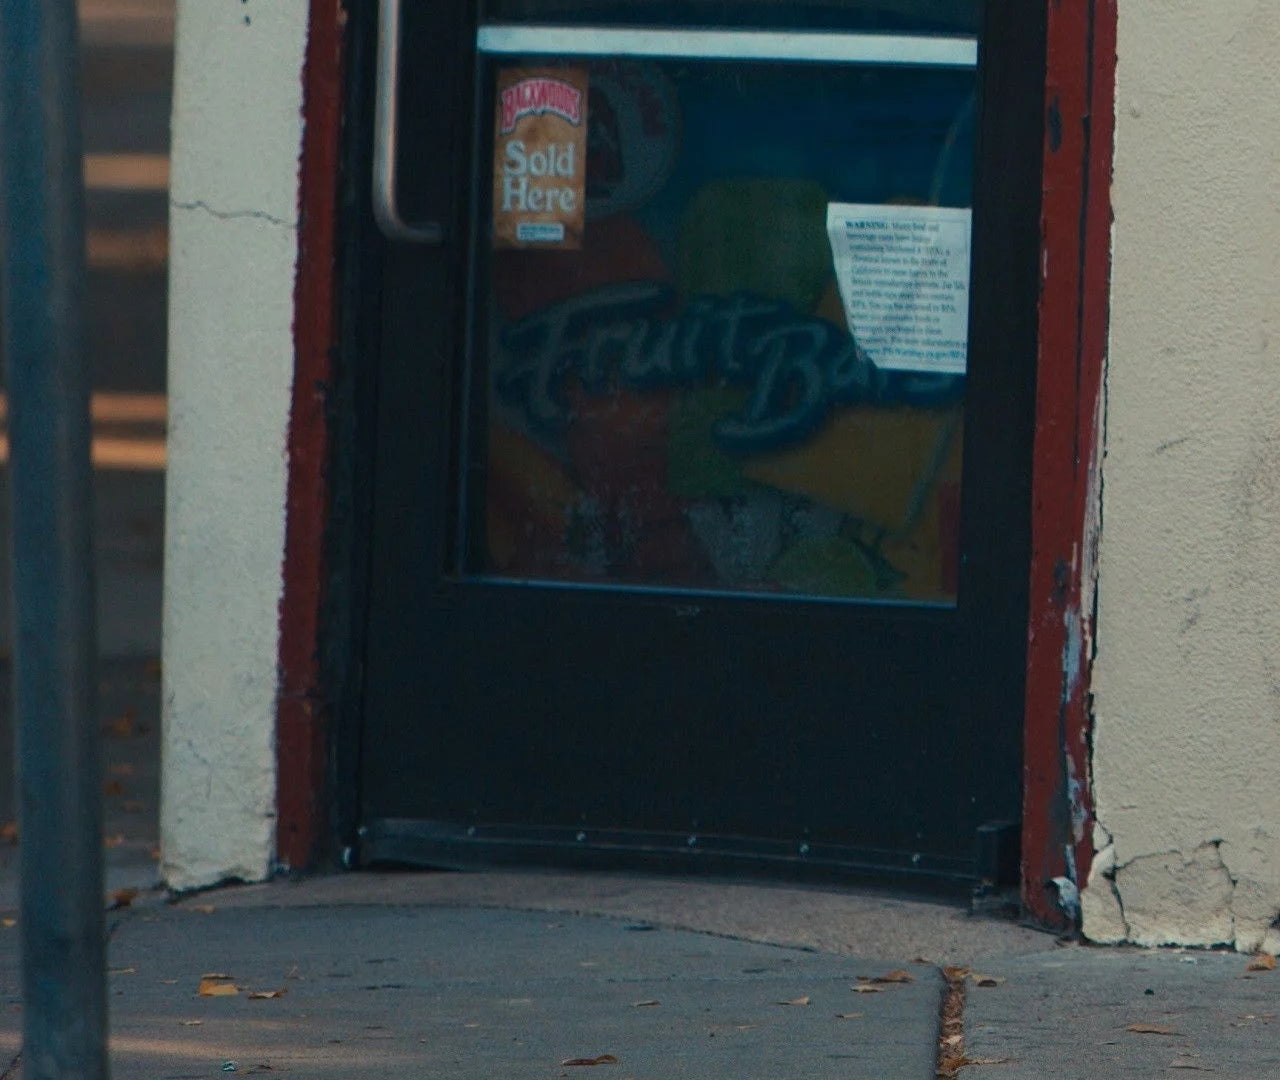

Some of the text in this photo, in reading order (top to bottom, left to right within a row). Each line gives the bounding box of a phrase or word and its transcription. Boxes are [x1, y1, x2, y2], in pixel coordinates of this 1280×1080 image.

[503, 139, 576, 177] Sold
[502, 177, 577, 213] Here
[500, 282, 782, 419] Fruit
